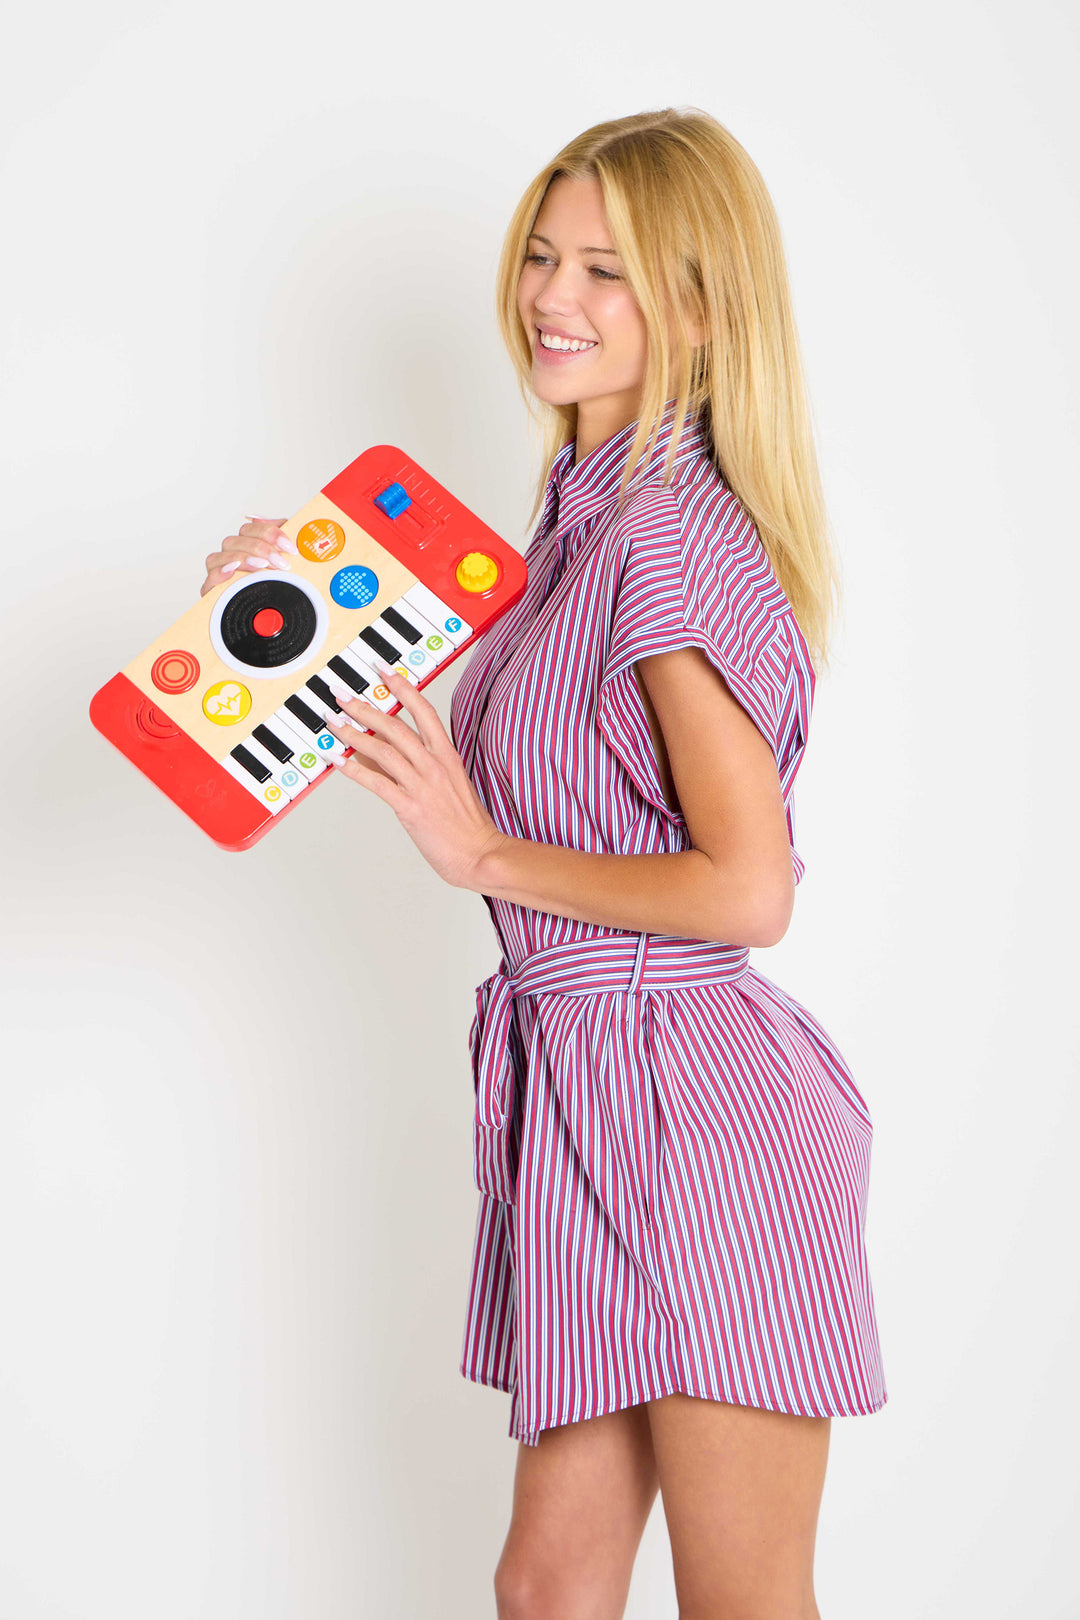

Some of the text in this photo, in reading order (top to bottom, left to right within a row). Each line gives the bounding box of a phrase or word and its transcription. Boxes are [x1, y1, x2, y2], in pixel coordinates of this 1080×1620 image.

[411, 651, 425, 664] D
[374, 685, 389, 699] B
[320, 735, 331, 749] F
[301, 754, 316, 767] E
[283, 771, 297, 785] D
[266, 787, 279, 800] C
